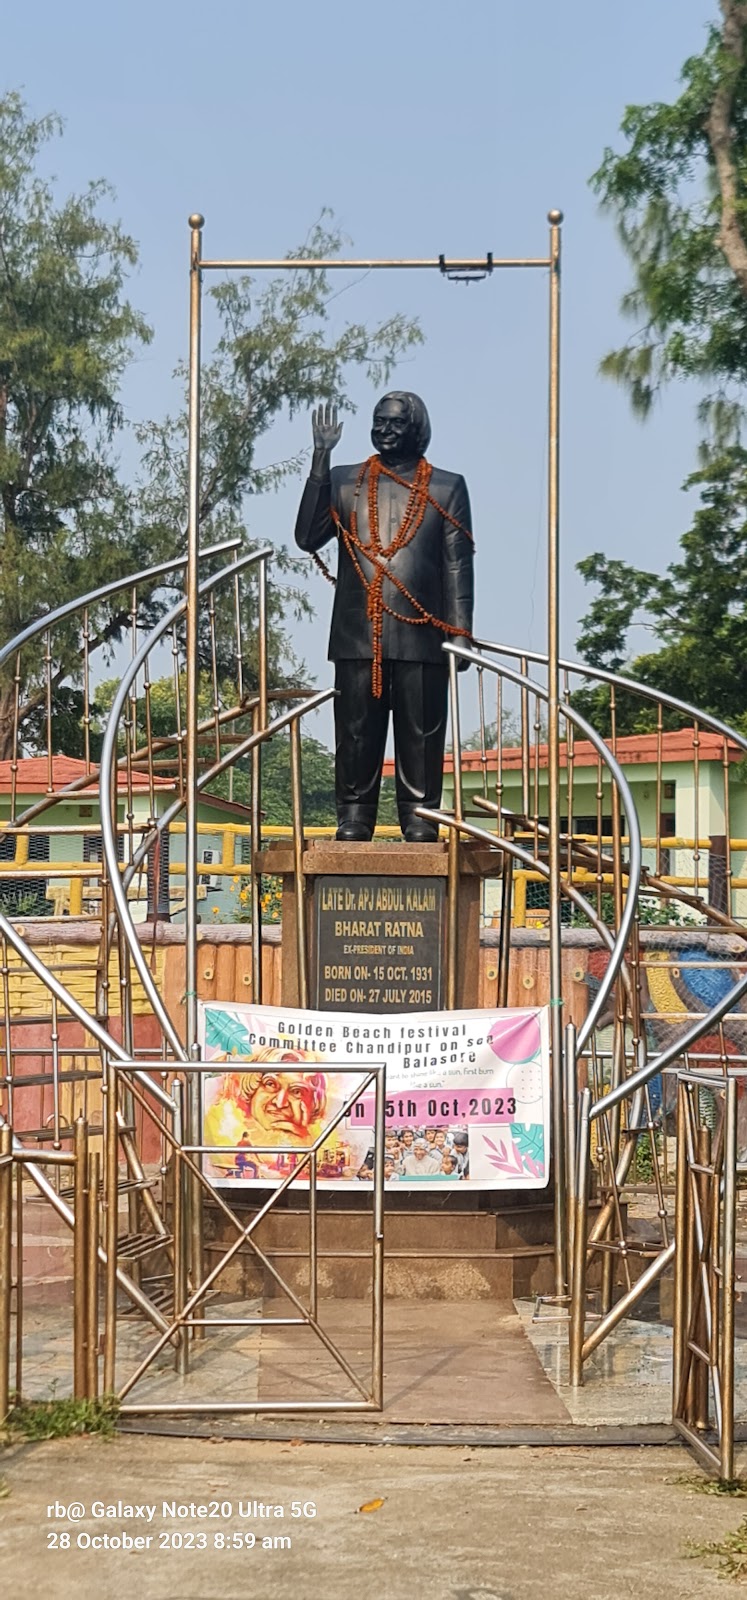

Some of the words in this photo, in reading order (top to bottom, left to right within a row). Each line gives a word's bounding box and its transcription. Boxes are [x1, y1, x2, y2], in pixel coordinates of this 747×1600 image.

[322, 888, 343, 911] LATE
[345, 888, 356, 911] Dr.
[358, 888, 374, 911] APJ
[376, 888, 404, 911] ABDUL
[406, 888, 436, 911] KALAM
[335, 921, 381, 937] BHARAT
[385, 921, 424, 938] RATNA
[343, 944, 386, 955] EX-PRESIDENT
[387, 945, 397, 955] OF
[397, 945, 414, 955] INDIA
[324, 965, 351, 980] BORN
[373, 966, 384, 980] 15
[387, 966, 408, 981] OCT.
[411, 967, 432, 981] 1931
[325, 988, 347, 1002] DIED
[369, 988, 380, 1003] 27
[383, 989, 407, 1003] JULY
[409, 989, 432, 1004] 2015
[278, 1021, 333, 1037] Golden
[343, 1026, 391, 1039] Beach
[400, 1024, 466, 1039] festival
[249, 1033, 336, 1053] Committee
[346, 1041, 431, 1055] Chandipur
[440, 1041, 458, 1052] on
[403, 1051, 476, 1069] Balasore
[428, 1098, 516, 1118] Oct,2023
